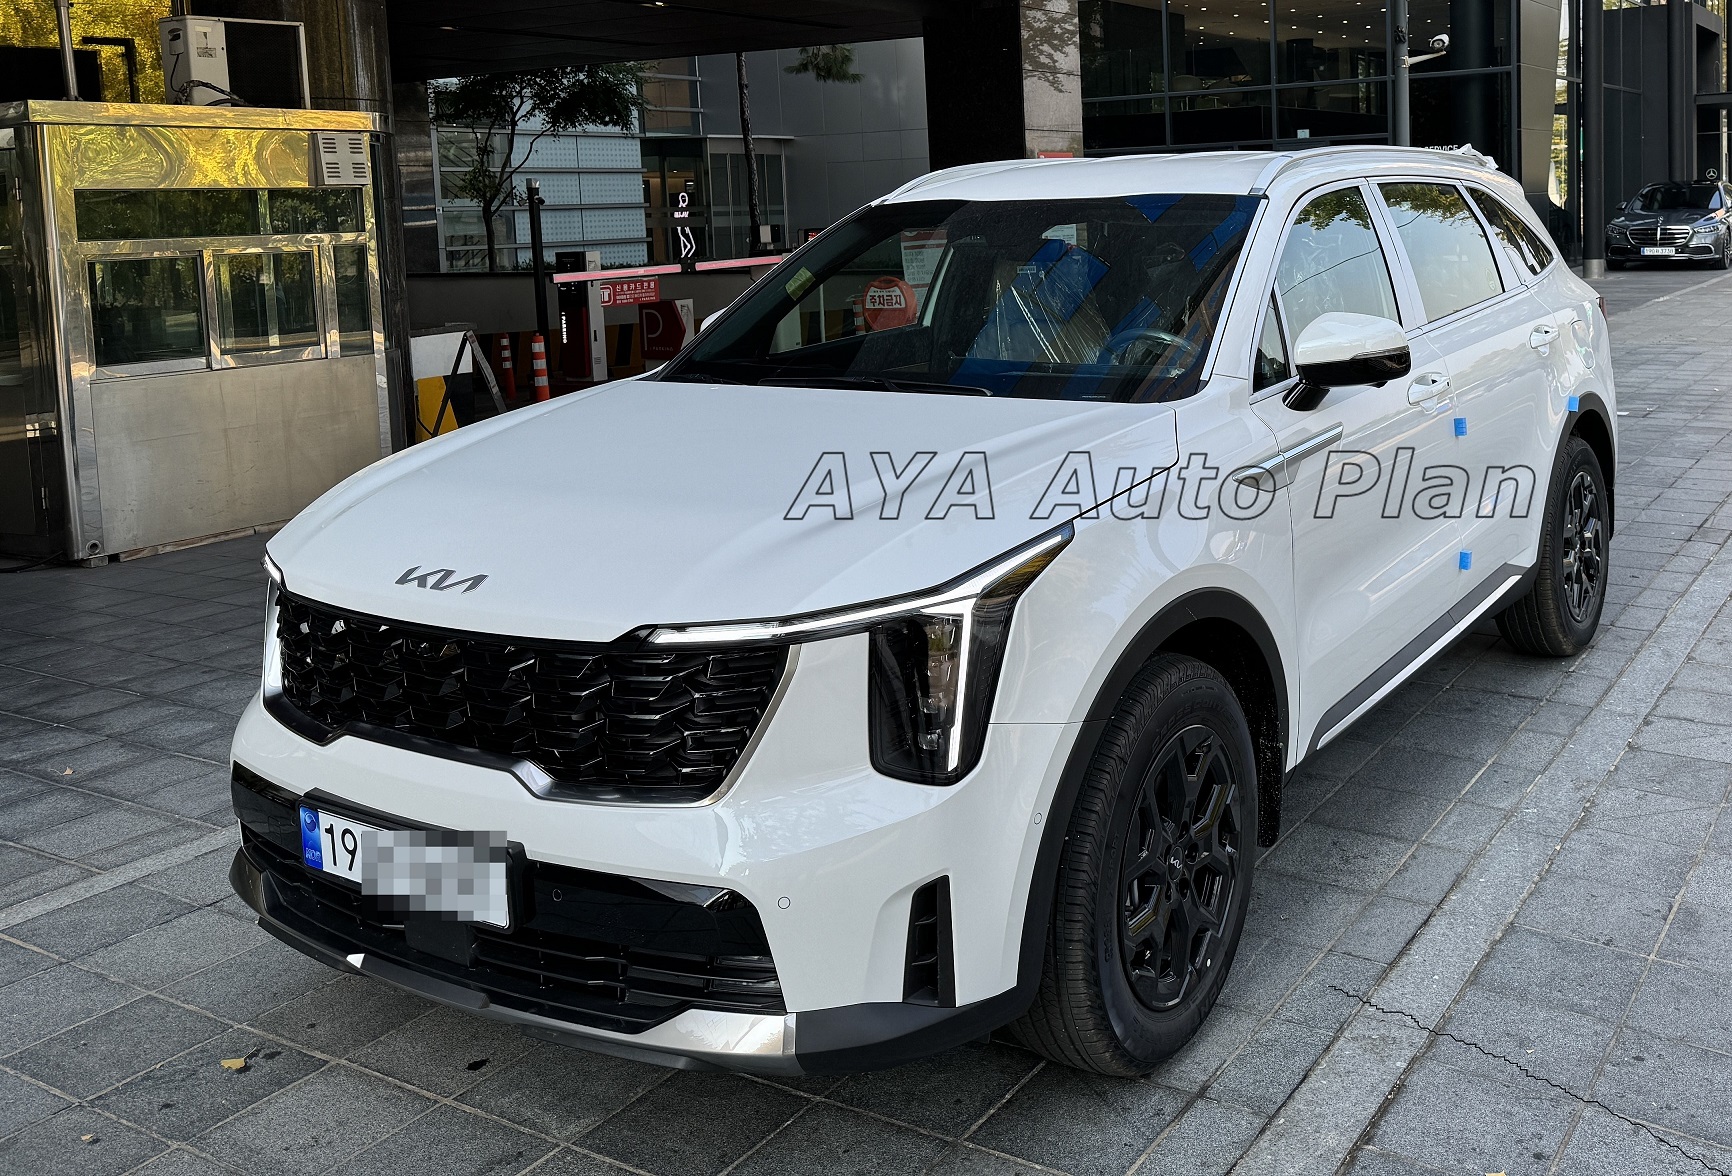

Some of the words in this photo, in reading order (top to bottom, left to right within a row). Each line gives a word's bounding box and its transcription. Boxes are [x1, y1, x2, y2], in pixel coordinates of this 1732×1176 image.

[869, 294, 902, 307] 주차금지
[642, 309, 663, 351] P
[394, 565, 490, 595] KIA
[324, 822, 362, 872] 19
